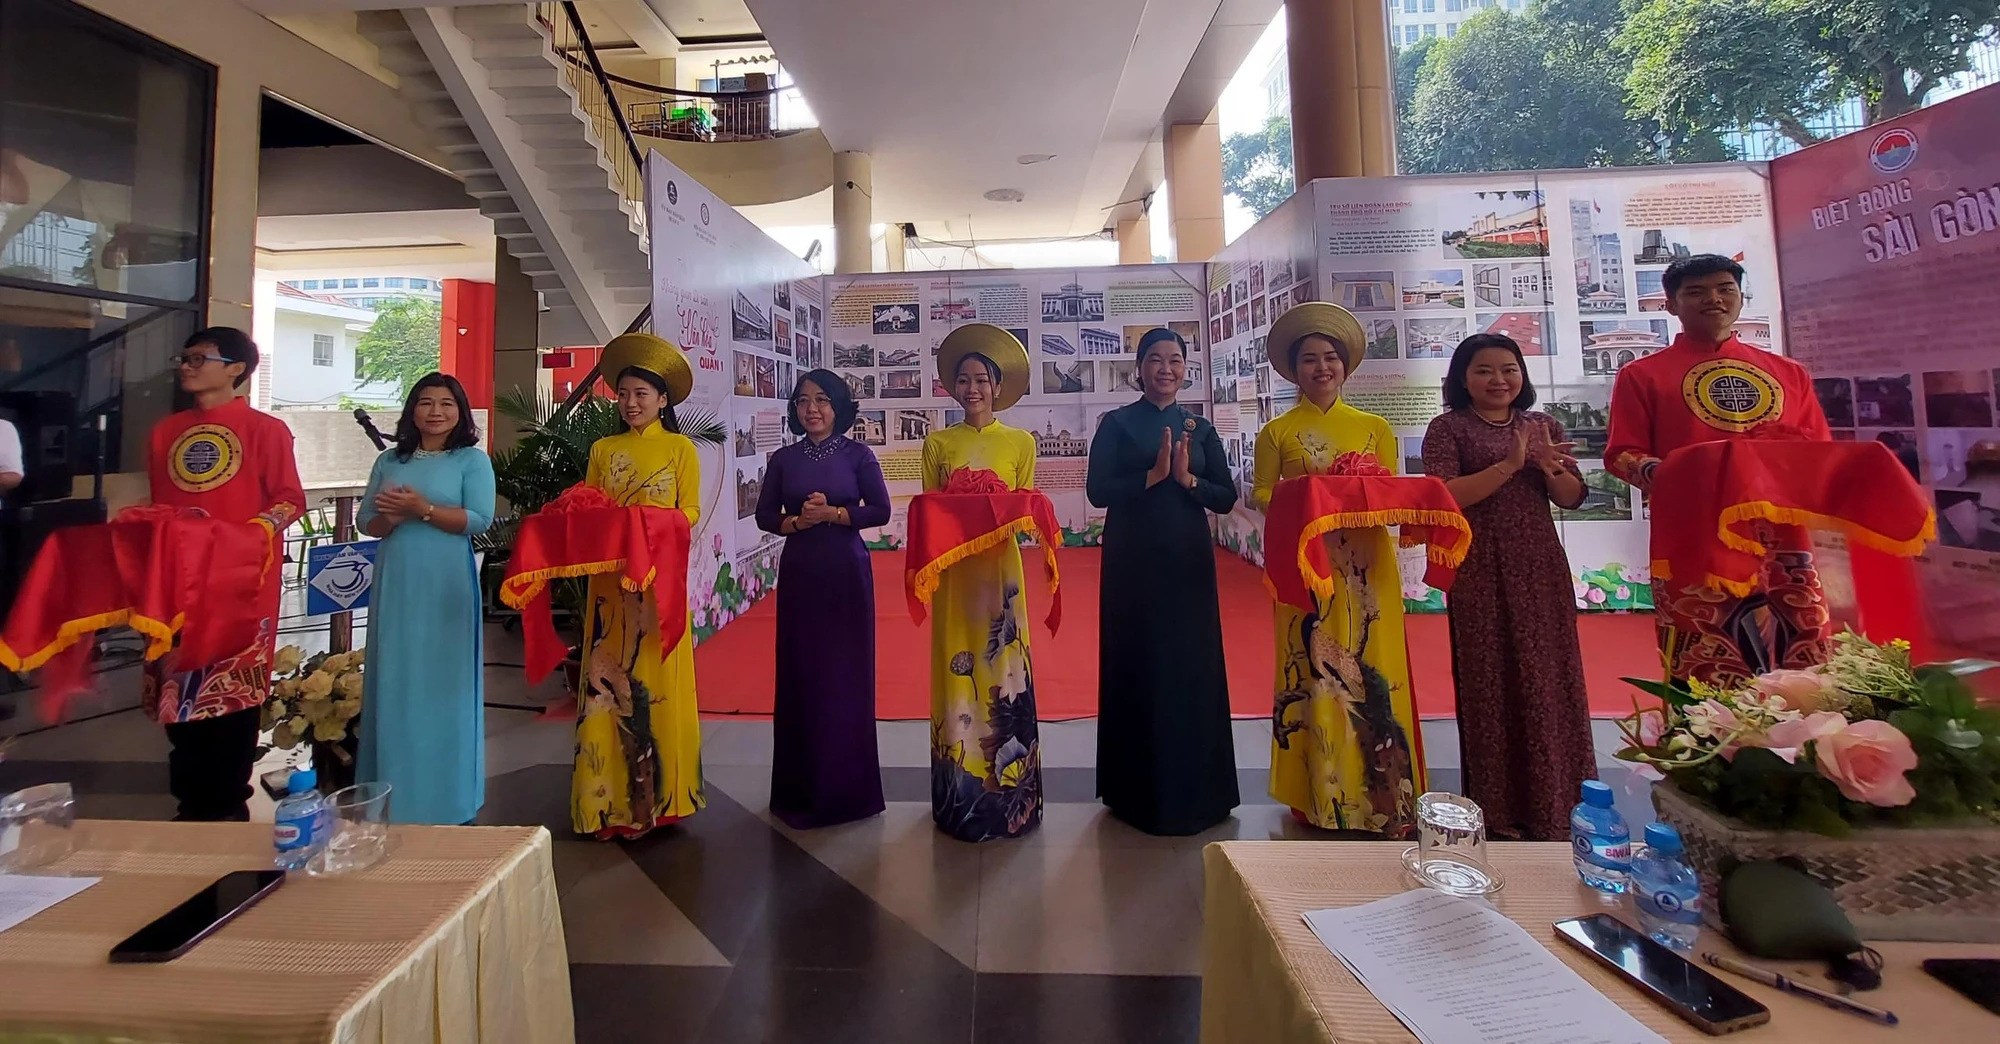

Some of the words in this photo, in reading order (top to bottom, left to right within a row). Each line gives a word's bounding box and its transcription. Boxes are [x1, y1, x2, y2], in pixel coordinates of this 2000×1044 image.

[1811, 199, 1850, 230] BIỆT
[1857, 178, 1912, 215] ĐỘNG
[1861, 211, 1920, 263] SÀI
[1930, 183, 2000, 243] GÒN
[700, 356, 719, 373] QUẬN
